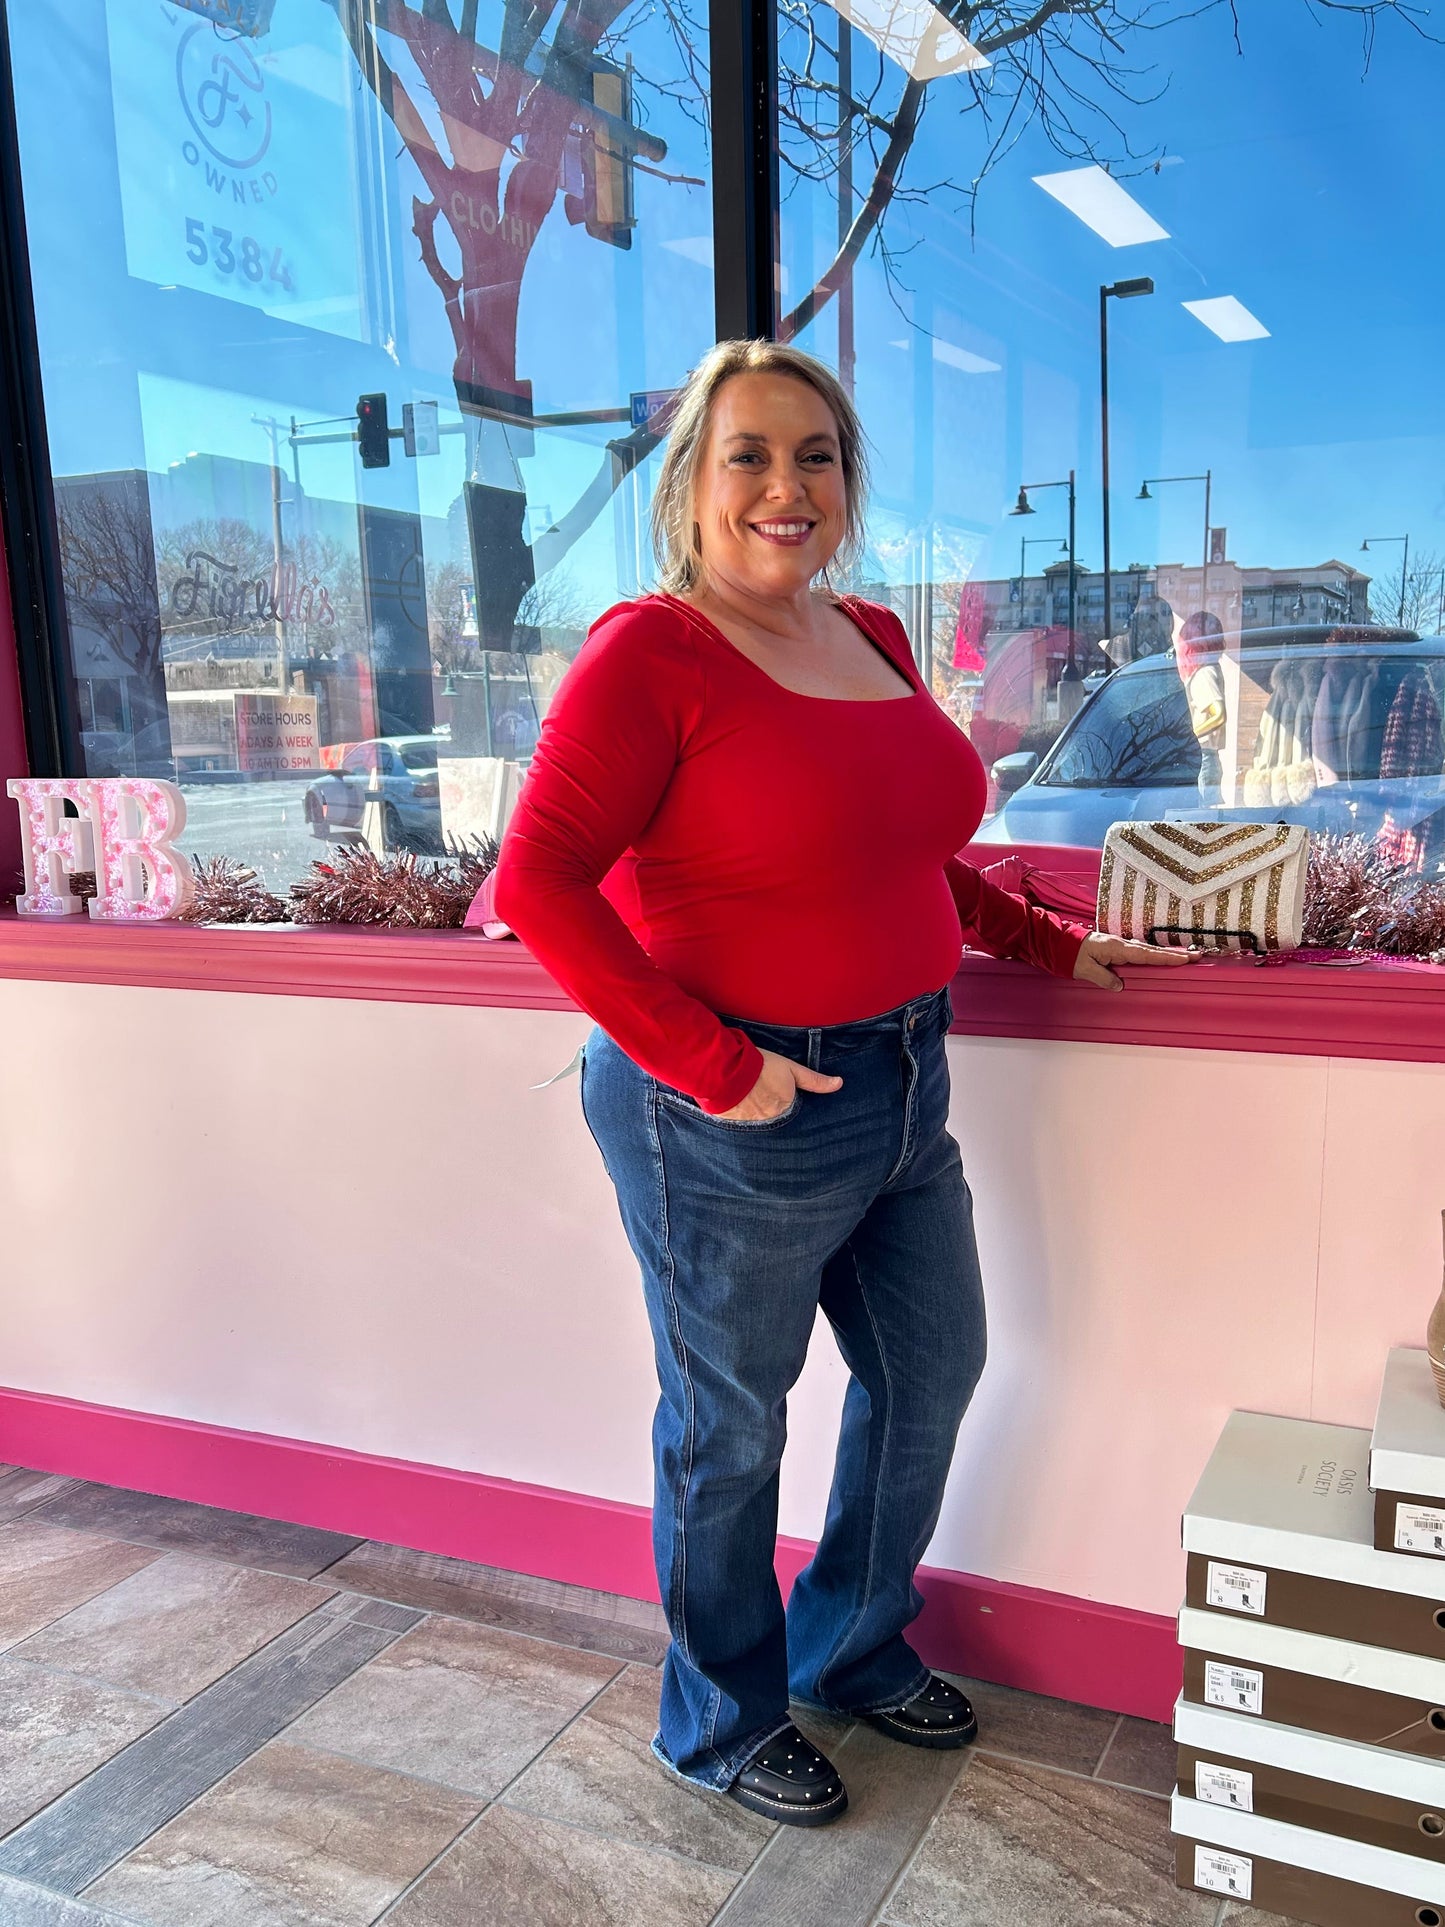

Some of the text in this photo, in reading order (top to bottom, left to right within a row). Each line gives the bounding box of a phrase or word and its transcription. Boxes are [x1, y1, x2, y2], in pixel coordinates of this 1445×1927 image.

[182, 140, 278, 204] OWNED
[185, 216, 294, 292] 5384
[240, 712, 312, 726] STORE HOURS
[247, 736, 274, 748] DAYS
[275, 736, 284, 748] A
[285, 736, 314, 748] WEEK
[257, 757, 273, 769] AM
[274, 757, 289, 769] TO
[291, 757, 312, 769] 5PM
[7, 778, 195, 920] FB
[1312, 1460, 1337, 1498] SOCIETY
[1336, 1469, 1357, 1496] OASIS
